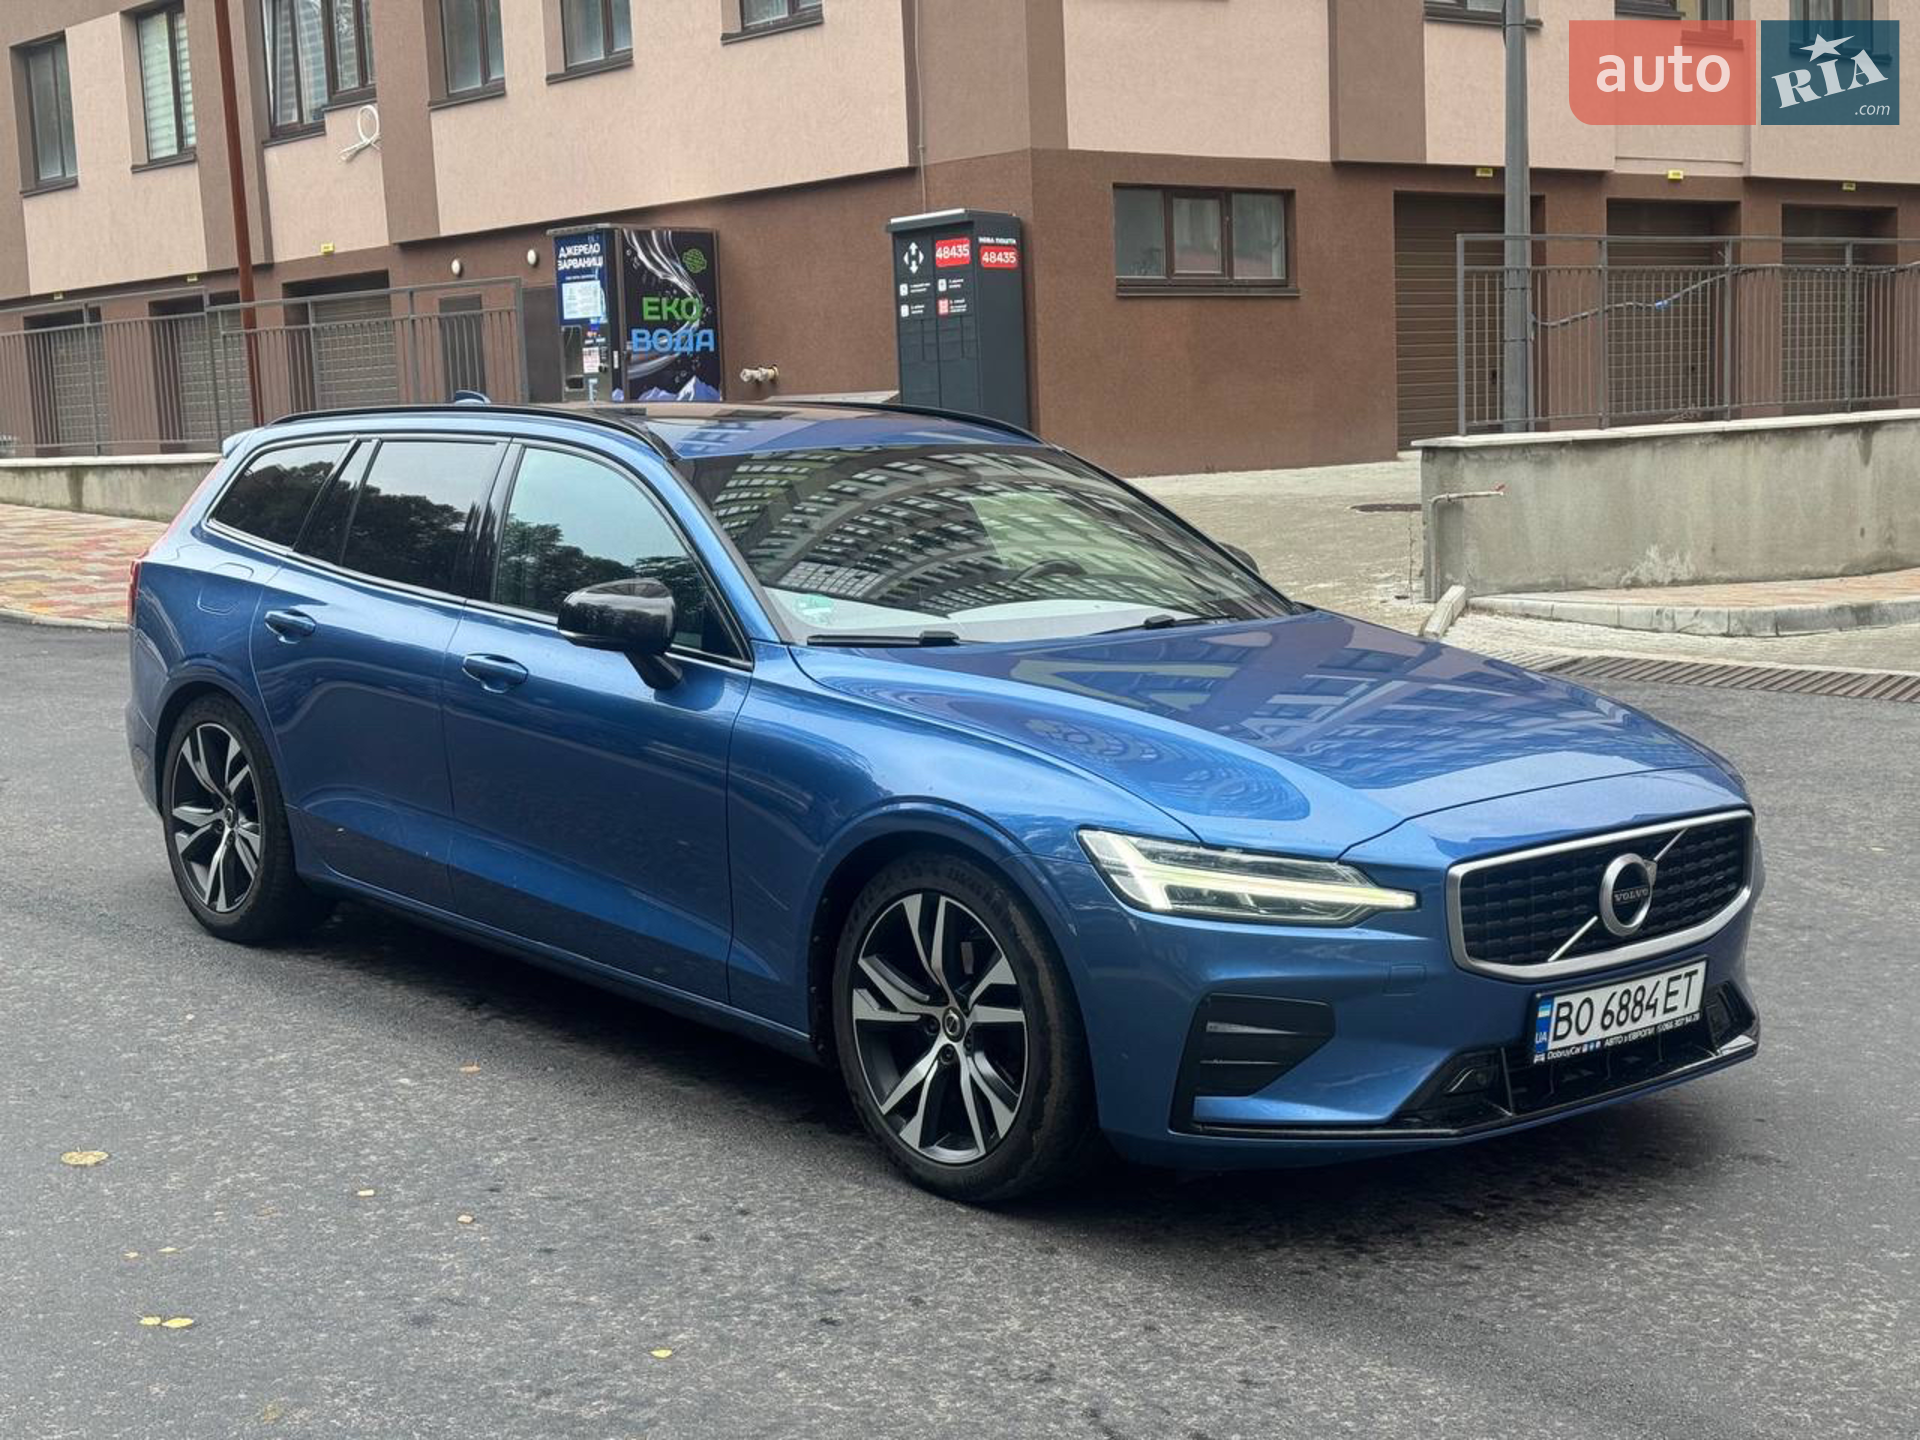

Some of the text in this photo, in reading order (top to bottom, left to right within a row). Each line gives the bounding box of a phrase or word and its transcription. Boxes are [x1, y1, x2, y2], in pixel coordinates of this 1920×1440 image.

[558, 243, 600, 258] ДЖЕРЕЛО
[936, 244, 970, 259] 48435
[982, 251, 1017, 263] 48435
[642, 296, 702, 322] ЕКО
[631, 328, 715, 354] ВОДА
[1614, 889, 1649, 902] VOLVO
[1552, 969, 1699, 1042] BO 6884 ET
[1535, 1031, 1547, 1044] UA
